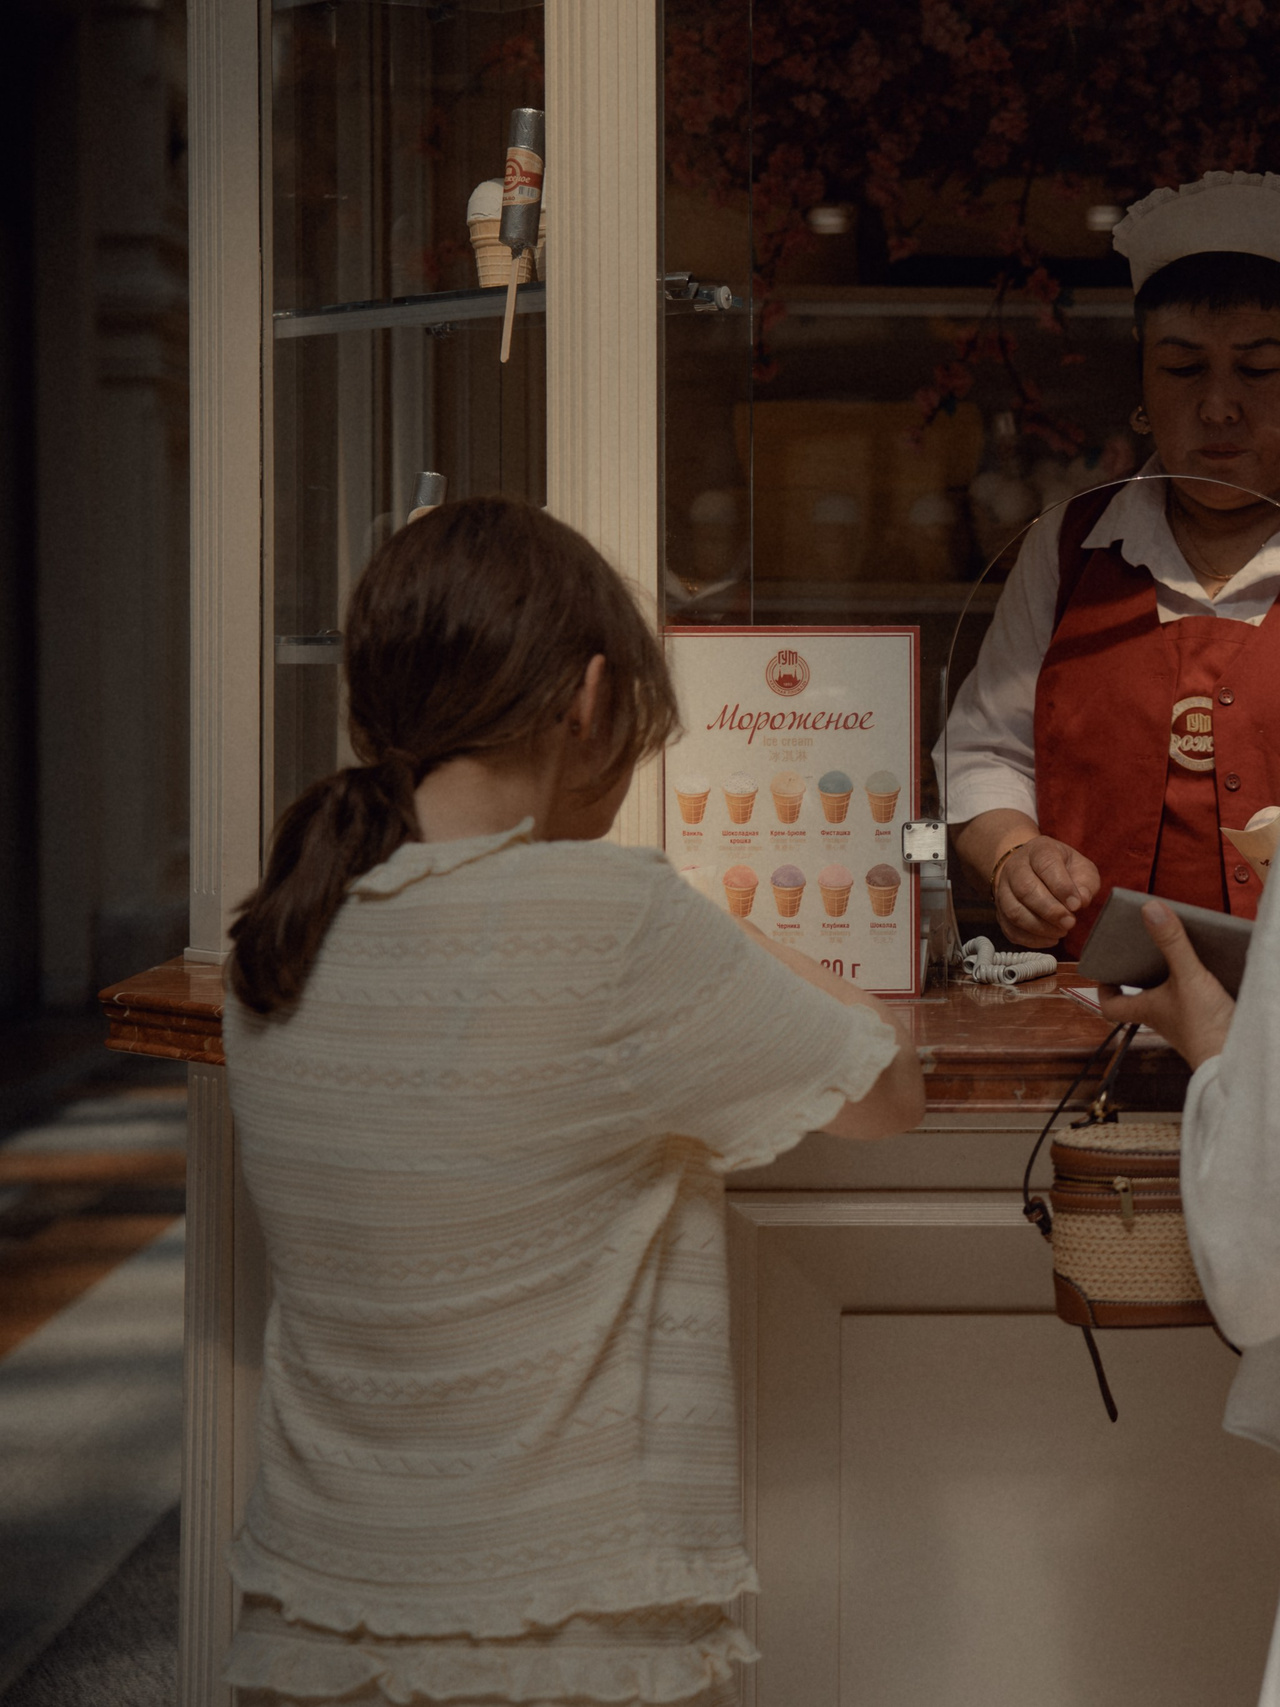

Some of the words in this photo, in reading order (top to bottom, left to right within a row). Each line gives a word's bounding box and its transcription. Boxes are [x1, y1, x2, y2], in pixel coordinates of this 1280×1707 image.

[777, 650, 798, 666] ГУМ
[706, 703, 876, 746] Мороженое
[781, 737, 814, 747] cream
[769, 750, 808, 762] 冰淇淋
[769, 830, 807, 838] Крем-брюле
[874, 829, 892, 837] Дыня
[776, 922, 801, 930] Черника
[821, 922, 851, 930] Клубника
[869, 922, 898, 930] Шоколад
